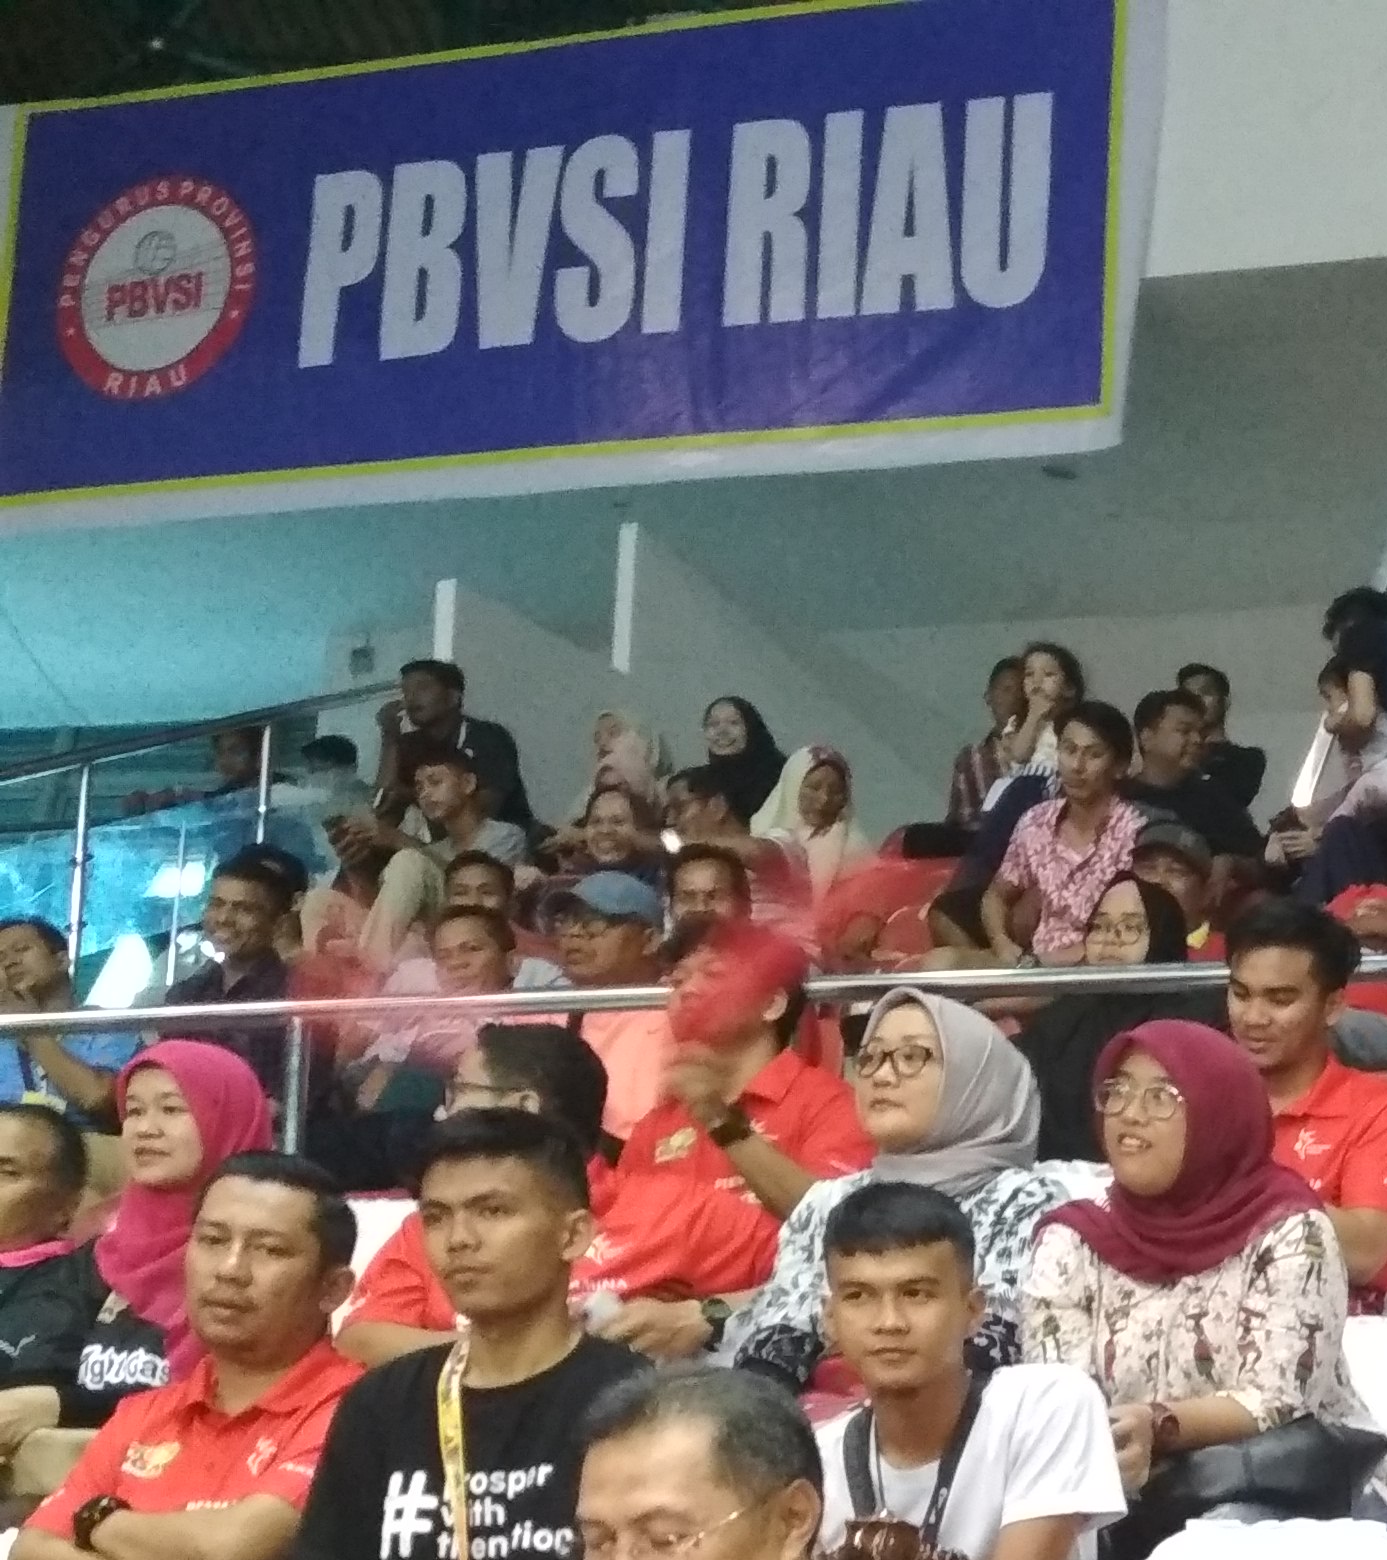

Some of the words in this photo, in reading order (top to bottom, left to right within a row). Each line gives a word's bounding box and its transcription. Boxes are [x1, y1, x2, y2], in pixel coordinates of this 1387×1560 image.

[180, 180, 256, 290] PROVINSI
[297, 129, 692, 368] PBVSI
[722, 91, 1055, 327] RIAU
[104, 271, 204, 322] PBVSI
[104, 364, 188, 398] RIAU
